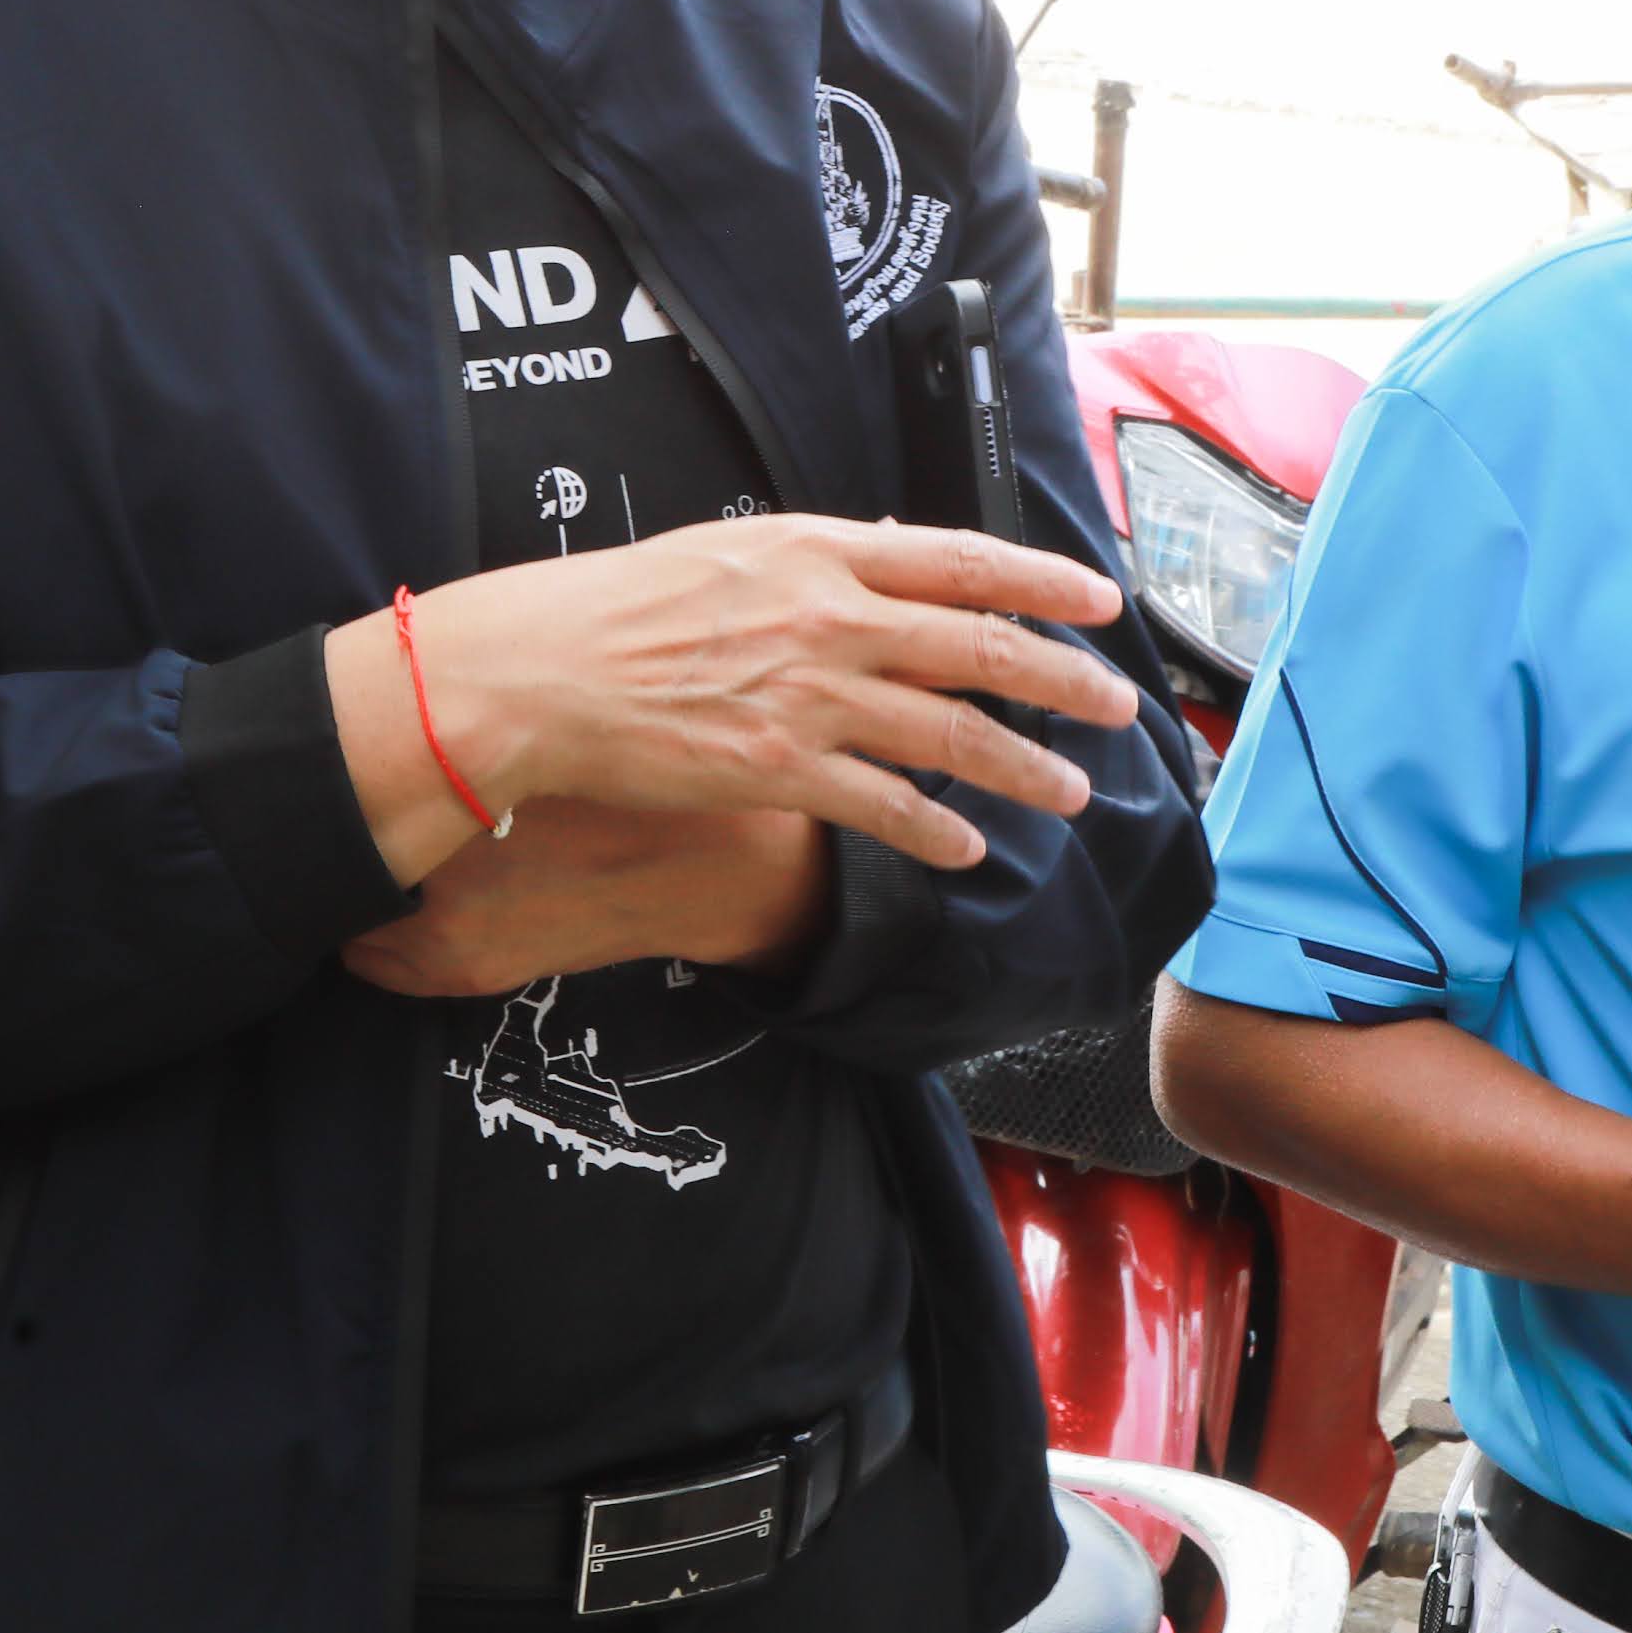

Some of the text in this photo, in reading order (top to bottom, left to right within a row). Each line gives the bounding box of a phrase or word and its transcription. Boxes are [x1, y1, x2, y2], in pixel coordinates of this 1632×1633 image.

[449, 245, 597, 332] ND
[889, 266, 924, 303] and
[910, 198, 952, 269] Society
